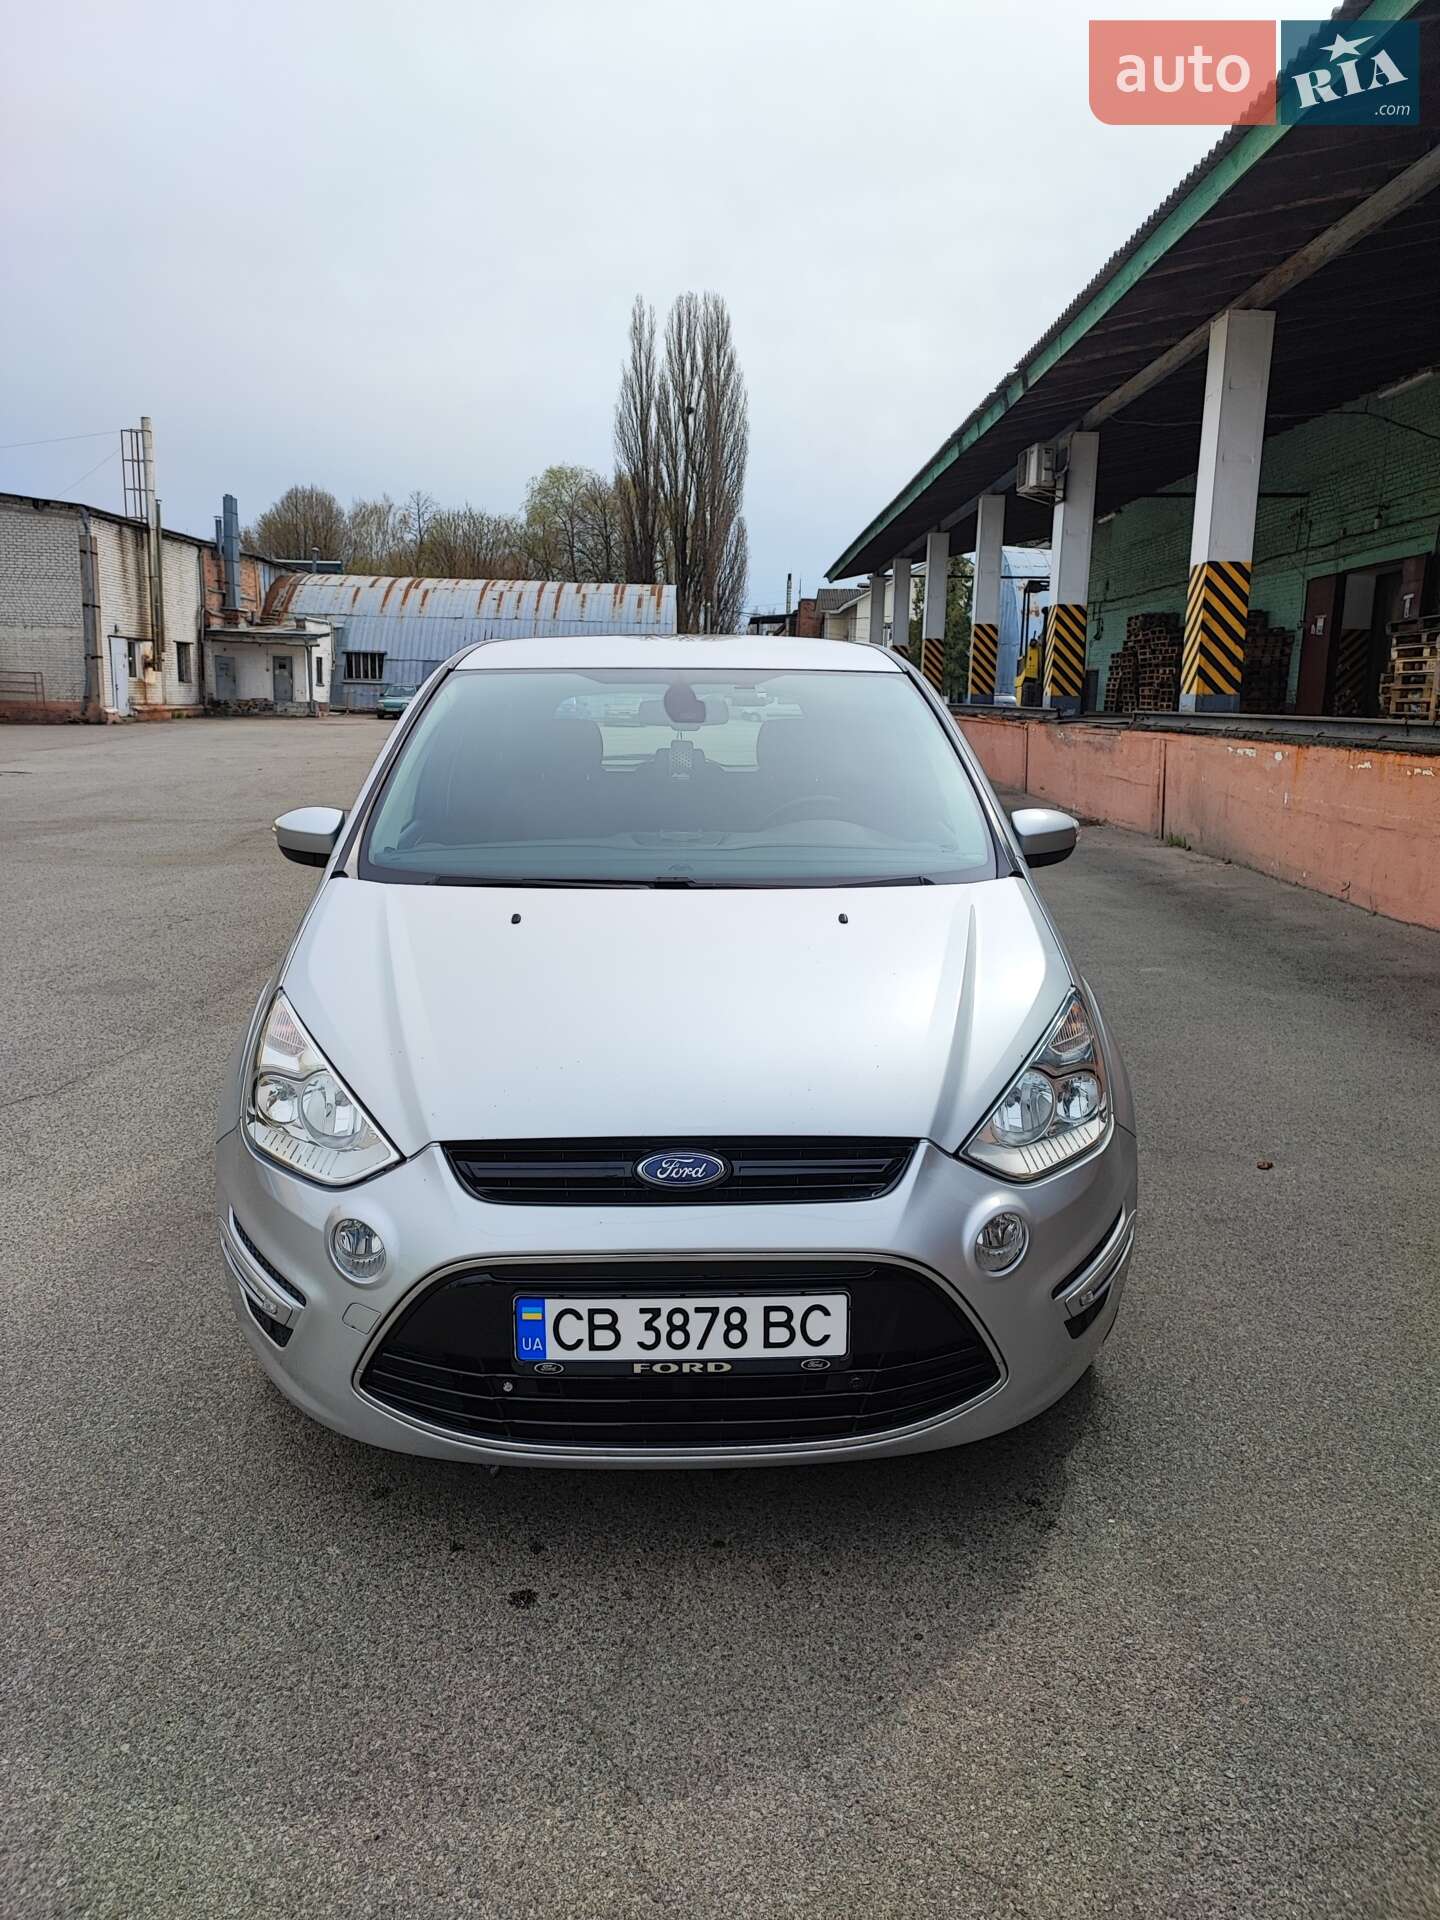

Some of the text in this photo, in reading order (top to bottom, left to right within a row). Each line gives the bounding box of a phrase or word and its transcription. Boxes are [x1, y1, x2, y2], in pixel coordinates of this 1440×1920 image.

[657, 1158, 706, 1178] Ford
[552, 1303, 831, 1351] CB 3878 BC
[522, 1337, 543, 1351] UA
[633, 1362, 732, 1374] FORD
